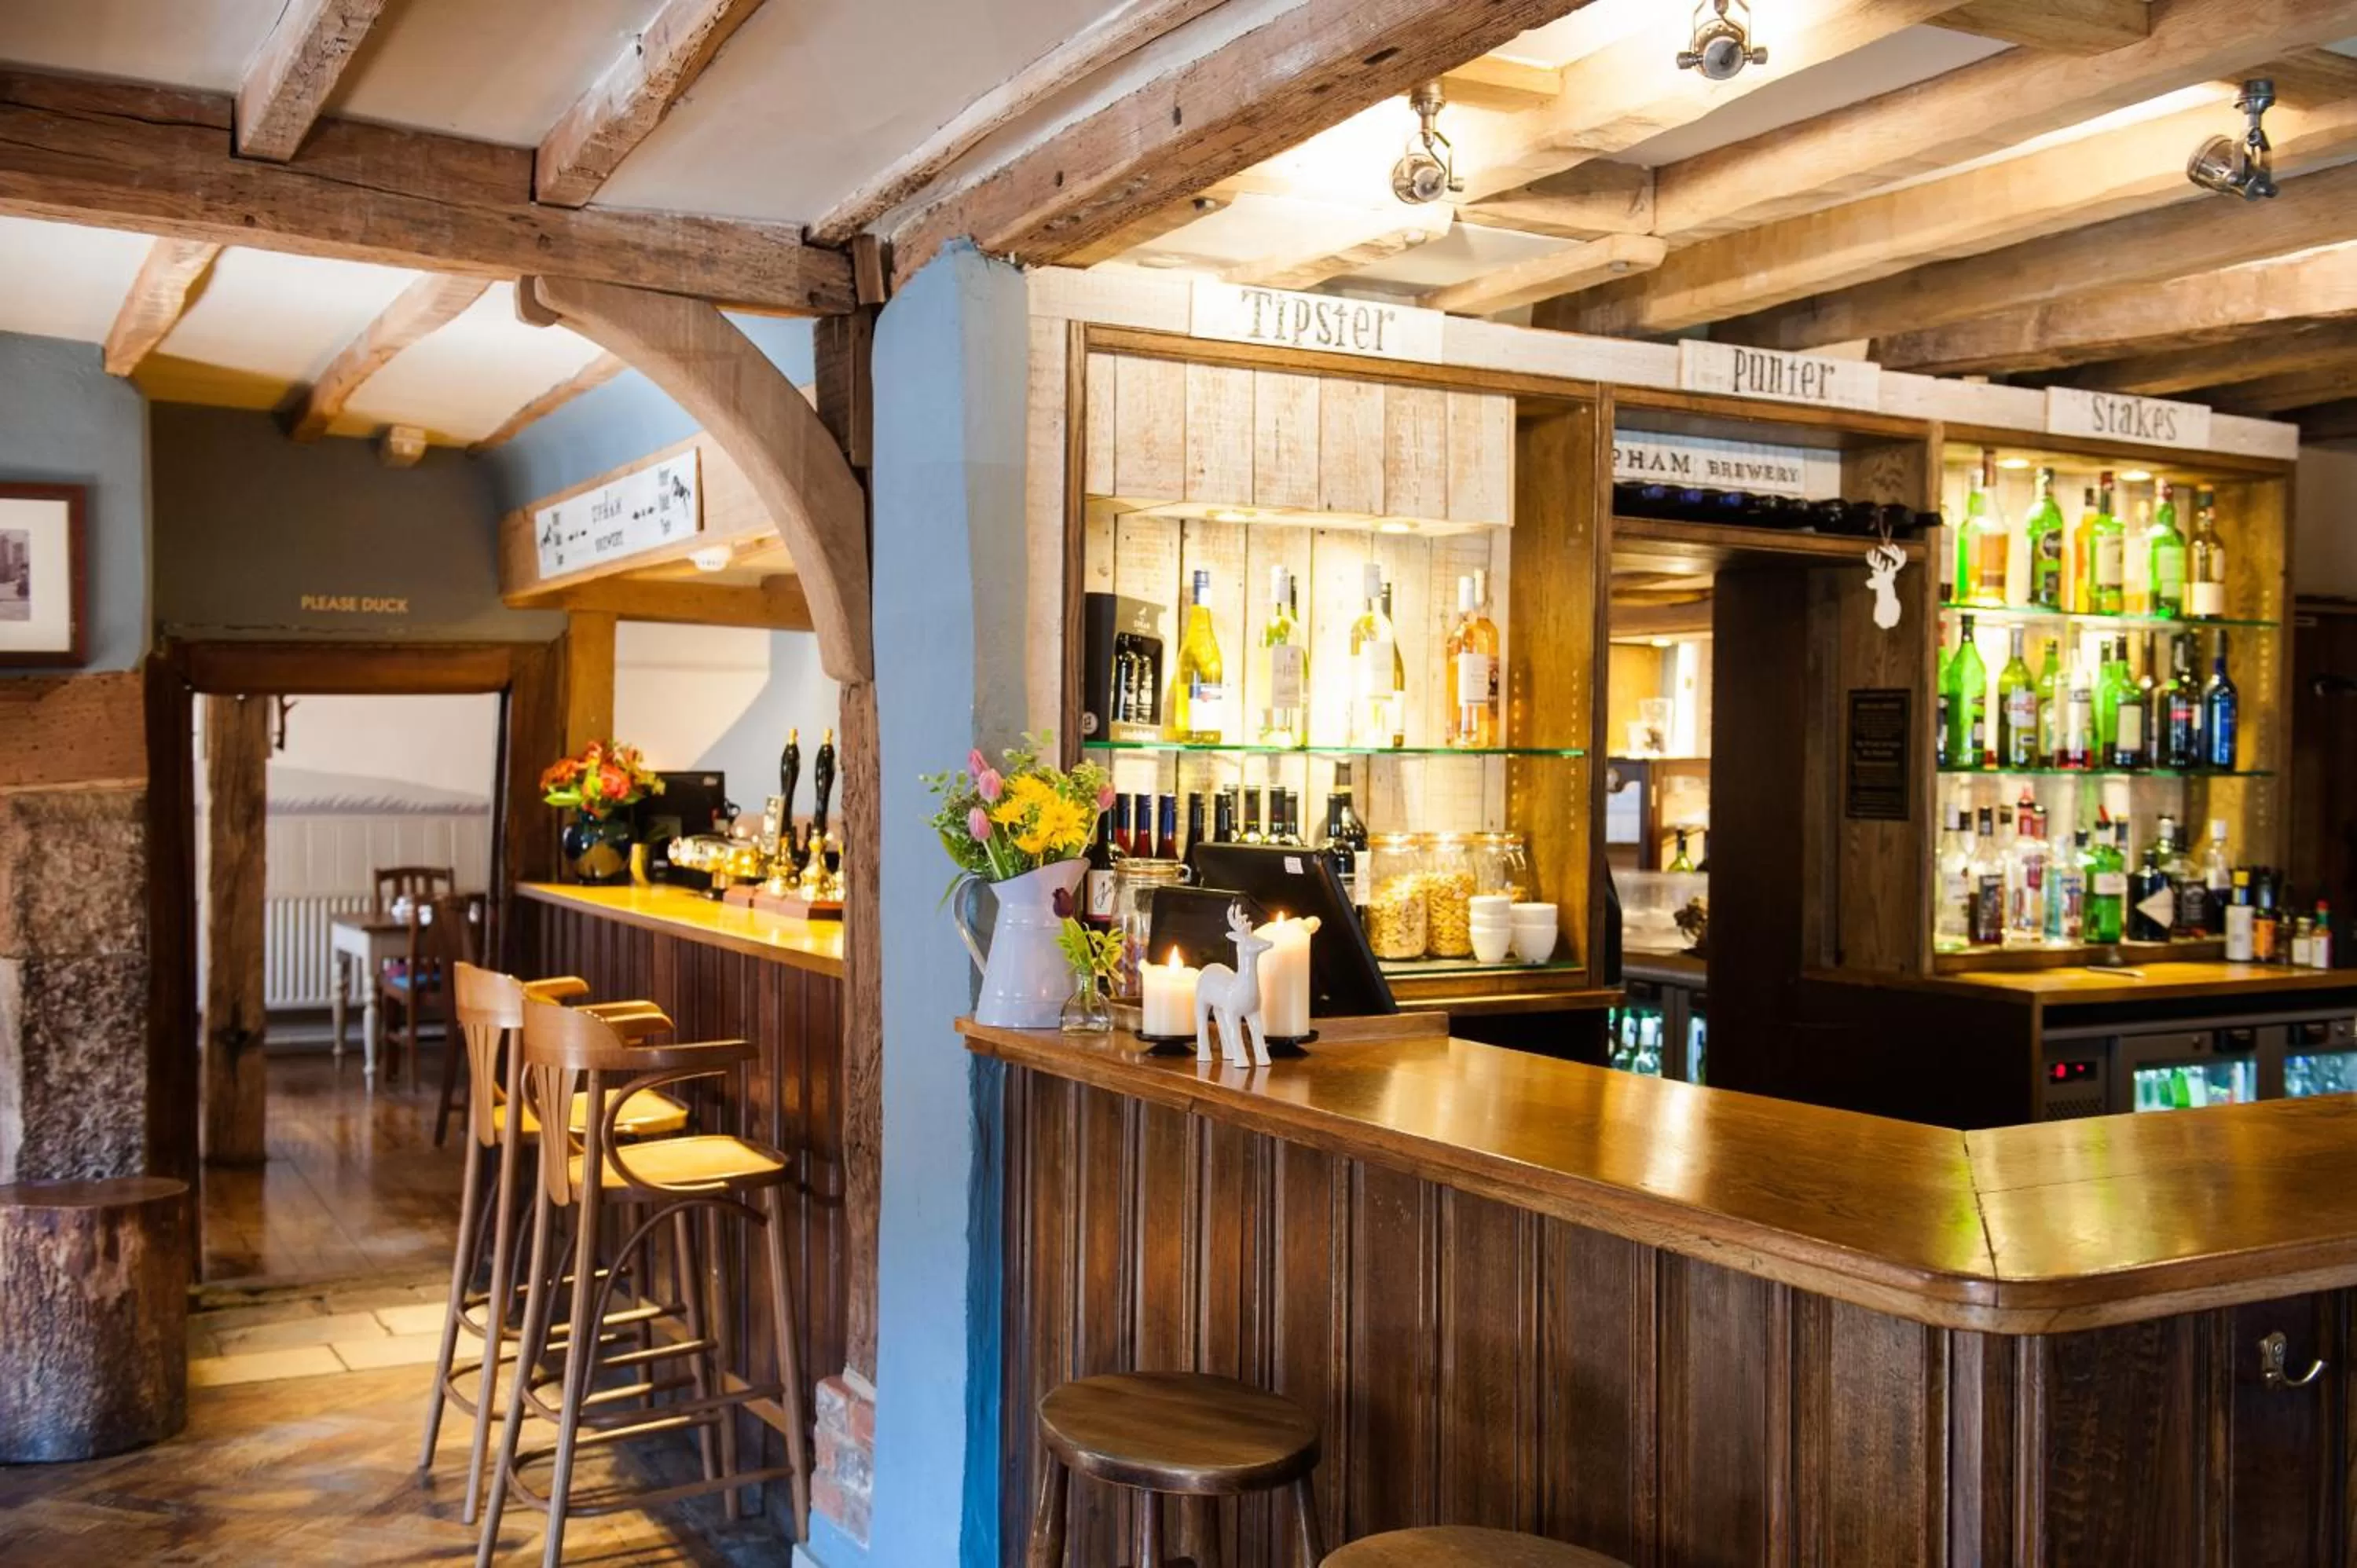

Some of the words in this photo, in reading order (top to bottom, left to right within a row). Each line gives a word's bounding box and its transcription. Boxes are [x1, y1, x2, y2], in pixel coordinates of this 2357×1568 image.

[1241, 288, 1395, 352] Tipster
[1733, 349, 1835, 400] Punter
[2092, 394, 2179, 441] Stakes
[1706, 459, 1799, 483] BREWERY
[301, 595, 356, 611] PLEASE
[361, 596, 409, 614] DUCK
